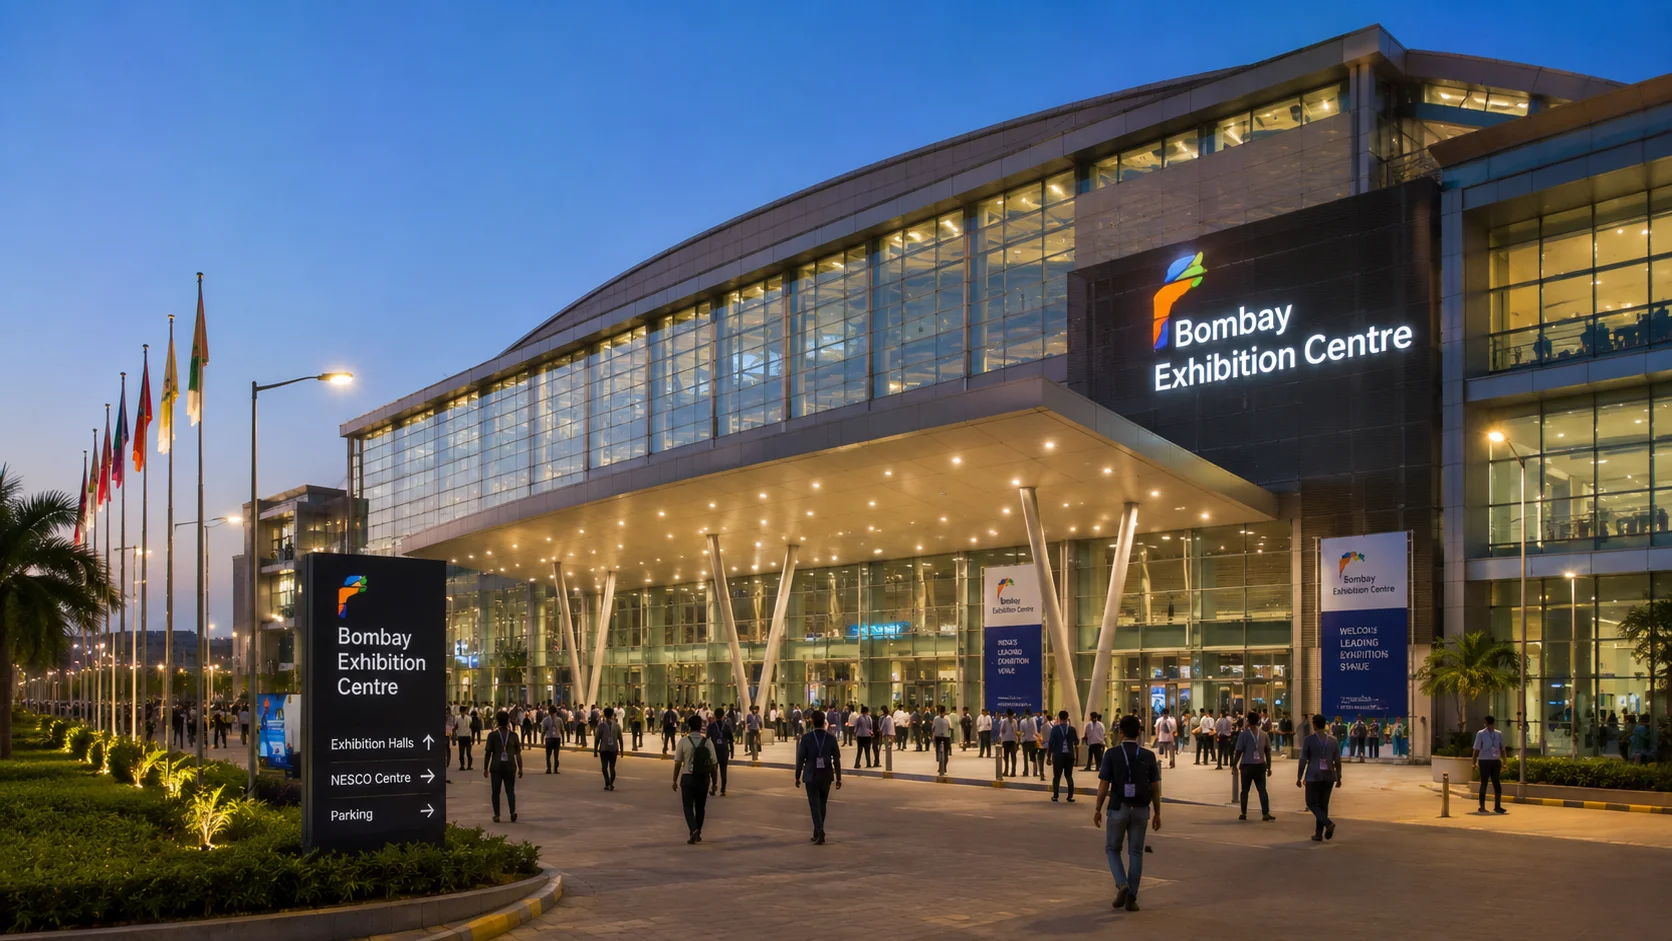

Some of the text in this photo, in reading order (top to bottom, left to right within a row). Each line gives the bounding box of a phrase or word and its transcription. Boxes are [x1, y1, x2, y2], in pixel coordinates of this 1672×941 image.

[1174, 304, 1293, 349] Bombay
[1154, 325, 1414, 392] Exhibition Centre
[1370, 585, 1396, 594] Centre
[338, 626, 412, 650] Bombay
[1340, 638, 1379, 648] LEADING
[338, 652, 427, 672] Exhibition
[337, 677, 399, 696] Centre
[331, 737, 415, 751] Exhibition Halls
[331, 772, 411, 786] NESCO Centre
[331, 808, 373, 822] Parking
